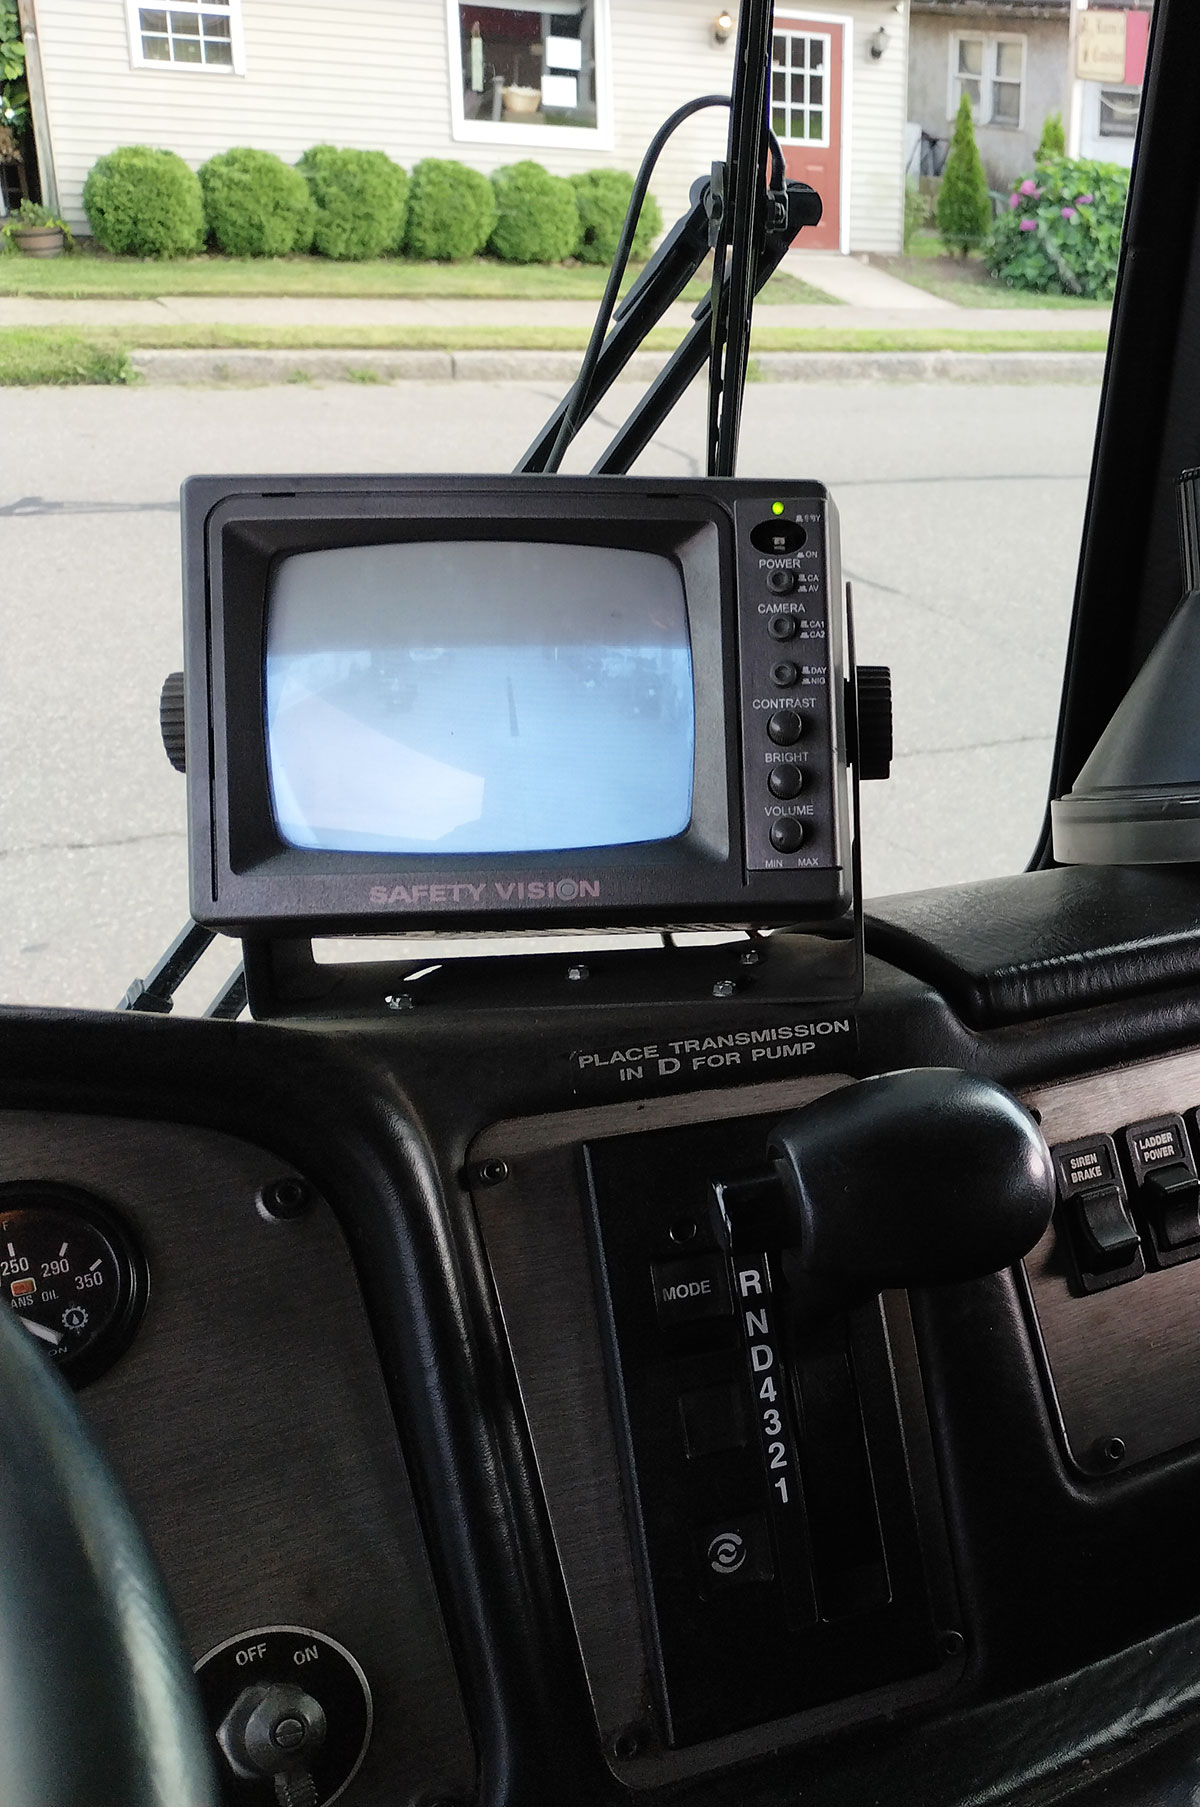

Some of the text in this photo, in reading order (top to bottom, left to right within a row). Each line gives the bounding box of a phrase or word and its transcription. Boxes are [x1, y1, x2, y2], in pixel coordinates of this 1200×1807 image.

[805, 550, 818, 558] ON
[758, 558, 801, 569] POWER
[807, 574, 819, 582] CA
[757, 603, 806, 614] CAMERA
[809, 620, 825, 628] CA1
[809, 631, 826, 639] CA2
[811, 667, 827, 675] DAY
[752, 697, 817, 710] CONTRAST
[764, 751, 809, 763] BRIGHT
[764, 804, 814, 817] VOLUME
[765, 857, 819, 868] MIN MAX
[369, 878, 600, 903] SAFETY VISION
[578, 1019, 850, 1069] PLACE TRANSMISSION
[619, 1041, 816, 1082] IN D FOR PUMP
[1138, 1131, 1174, 1150] LADDER
[1069, 1152, 1098, 1170] SIREN
[1143, 1144, 1176, 1163] POWER
[1070, 1166, 1103, 1184] BRAKE
[0, 1256, 30, 1277] 250
[40, 1258, 70, 1278] 290
[74, 1271, 104, 1291] 350
[10, 1289, 59, 1309] ANS OIL
[662, 1279, 712, 1302] MODE
[738, 1269, 789, 1503] R N D 4 3 2 1
[235, 1642, 319, 1666] OFF ON
